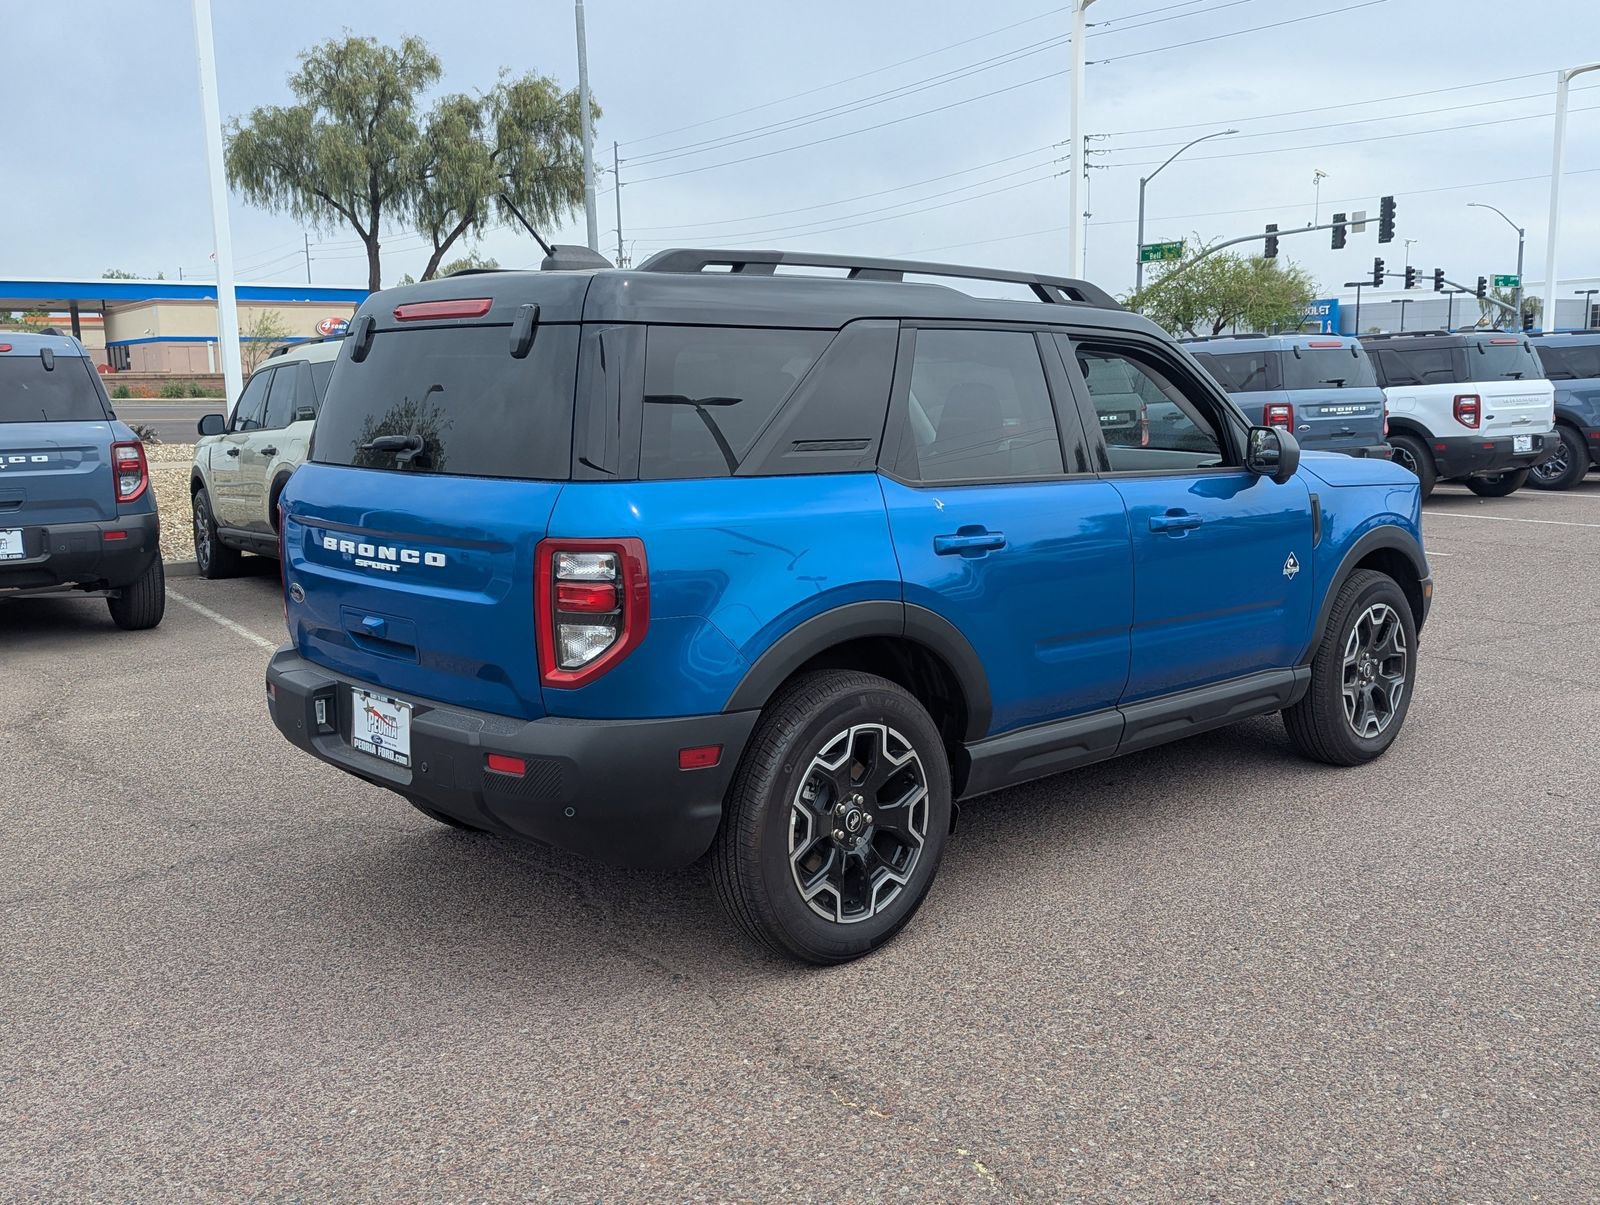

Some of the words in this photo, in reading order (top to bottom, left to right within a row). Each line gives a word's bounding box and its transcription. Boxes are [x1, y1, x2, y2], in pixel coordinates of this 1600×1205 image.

[321, 321, 331, 330] 4
[323, 536, 446, 567] BRONCO
[355, 559, 401, 572] SPORT
[367, 713, 398, 740] PEORIA
[354, 737, 377, 755] PEORIA
